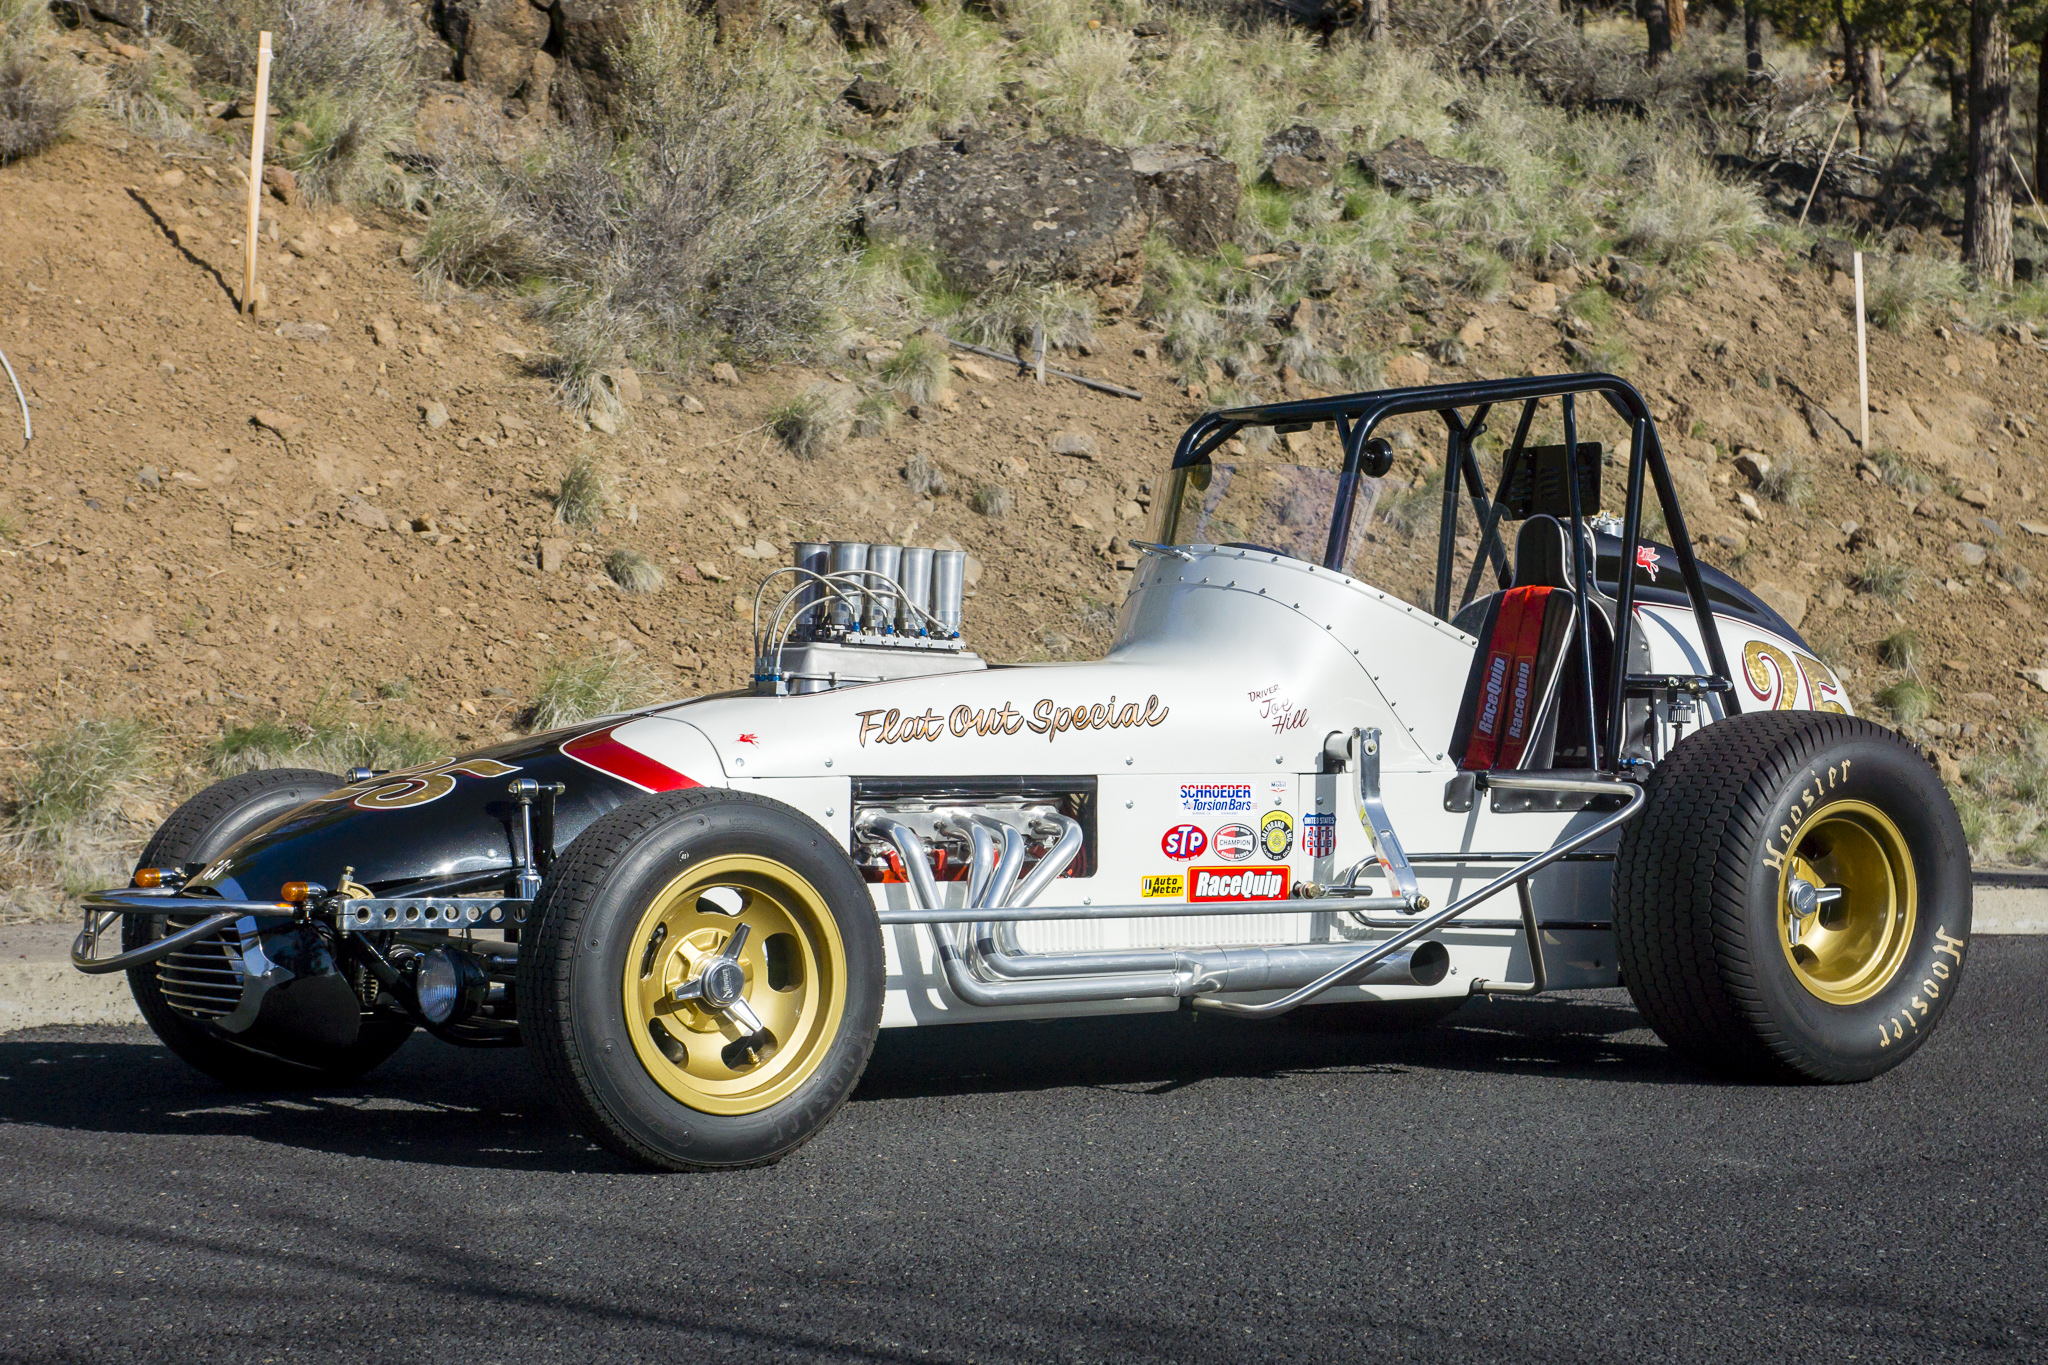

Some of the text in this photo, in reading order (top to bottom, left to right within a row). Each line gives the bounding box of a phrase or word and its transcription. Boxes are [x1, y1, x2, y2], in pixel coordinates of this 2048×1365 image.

[1248, 684, 1280, 702] DRIVER
[1478, 656, 1507, 735] RaceQuip
[1508, 661, 1530, 739] RaceQuip
[1259, 697, 1293, 719] Joe
[854, 694, 1169, 748] Flat Out Special
[1272, 708, 1309, 735] Hill
[1180, 784, 1251, 798] SCHROEDER
[1193, 799, 1252, 811] Torsion Bars
[1304, 817, 1335, 825] UNITED STATES
[1762, 758, 1851, 880] Hoosier
[1165, 825, 1204, 857] STP
[1306, 840, 1332, 848] CLUB
[1307, 829, 1333, 838] AUTO
[1152, 886, 1183, 895] Meter
[1154, 877, 1178, 886] Auto
[1195, 870, 1283, 899] RaceQuip
[1880, 924, 1964, 1048] Hoosier
